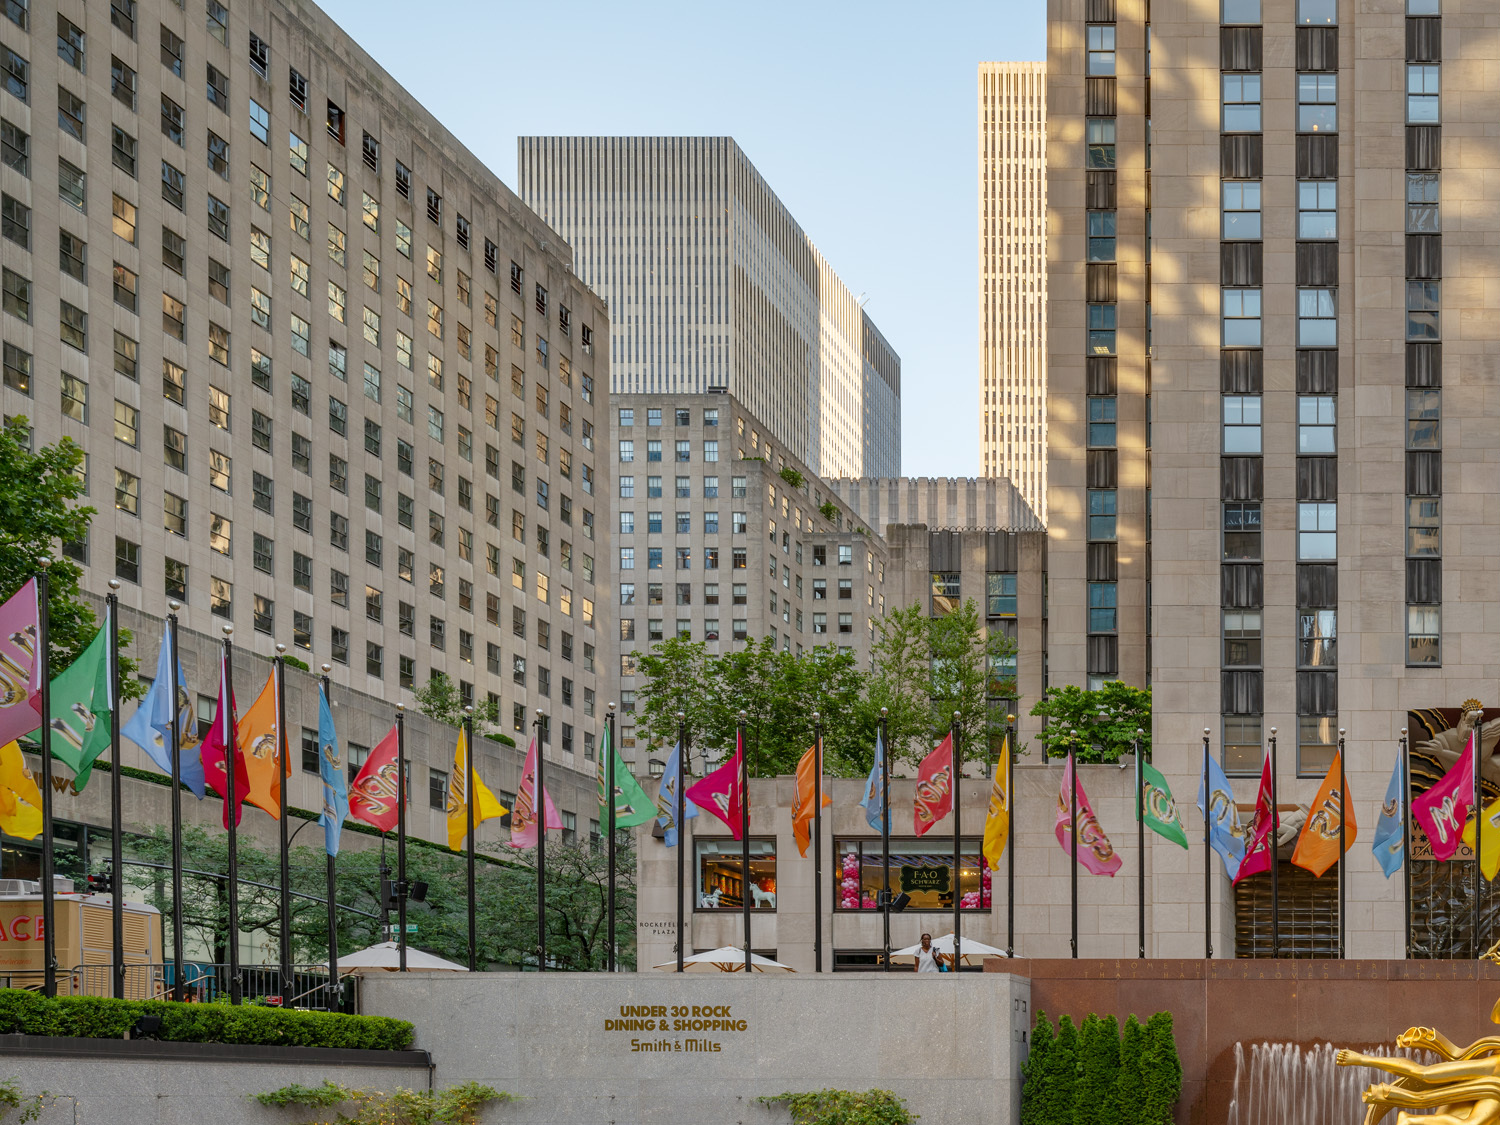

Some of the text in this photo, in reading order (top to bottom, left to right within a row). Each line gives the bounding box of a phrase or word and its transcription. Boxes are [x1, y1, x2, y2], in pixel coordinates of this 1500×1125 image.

[1099, 962, 1249, 970] PROMETHEUS
[1275, 962, 1377, 970] TEACHER
[1405, 962, 1425, 970] IN
[621, 1006, 731, 1017] UNDER 30 ROCK
[605, 1020, 747, 1031] DINING & SHOPPING
[631, 1039, 722, 1052] Smith & Mills
